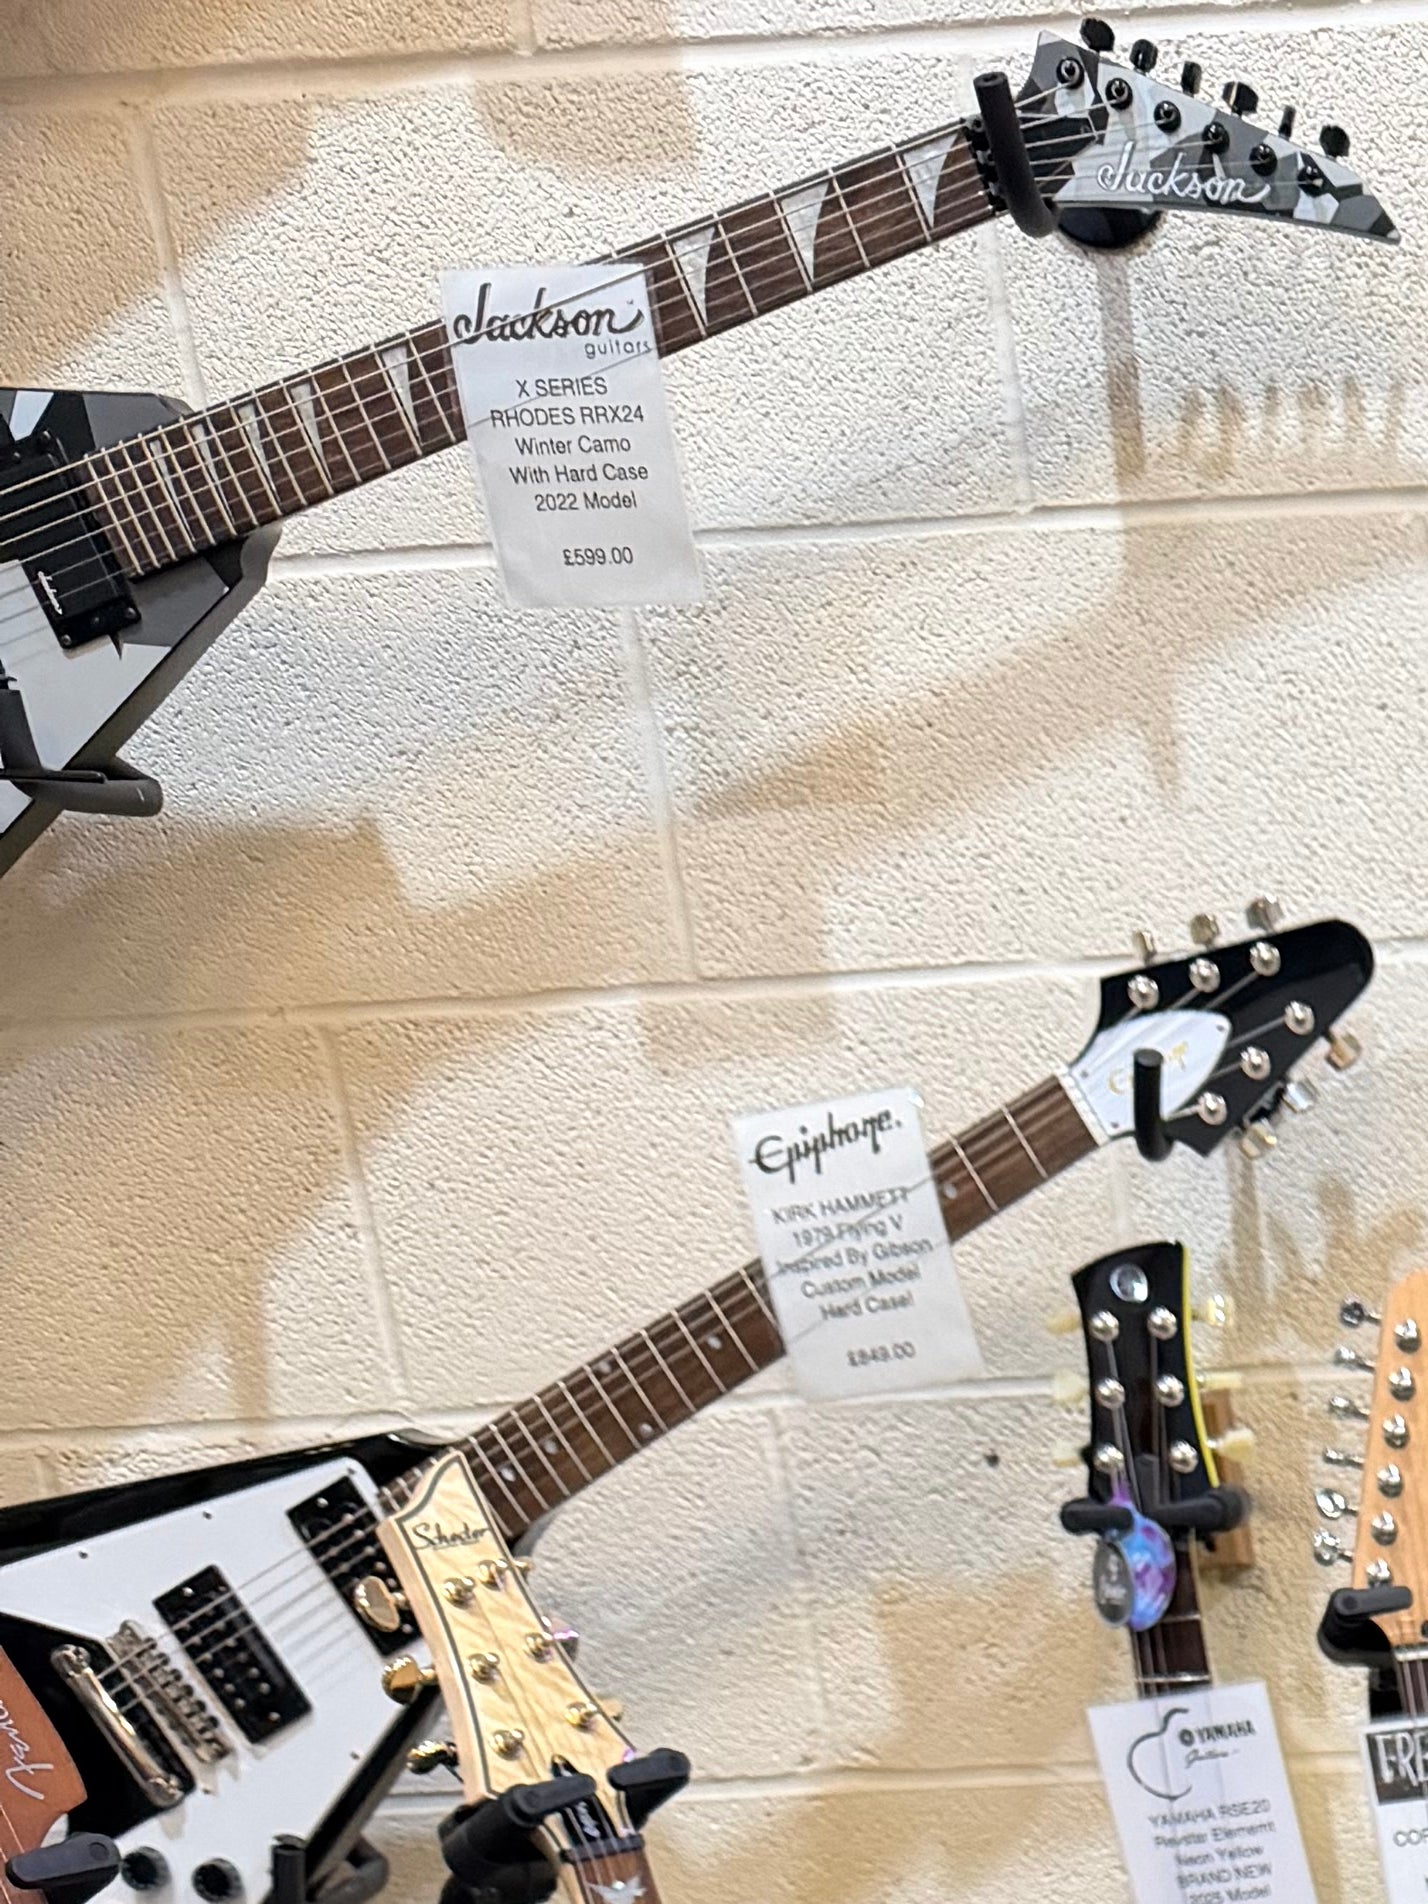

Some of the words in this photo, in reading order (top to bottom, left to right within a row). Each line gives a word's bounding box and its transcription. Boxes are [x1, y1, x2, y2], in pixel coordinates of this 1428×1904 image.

[1097, 141, 1270, 204] Jackson
[453, 282, 644, 344] Jackson
[584, 340, 650, 359] guitars
[516, 379, 530, 398] X
[536, 377, 608, 396] SERIES
[491, 407, 575, 428] RHODES
[581, 405, 644, 425] RRX24
[515, 436, 572, 456] Winter
[578, 435, 631, 453] Camo
[509, 465, 549, 485] With
[555, 465, 598, 483] Hard
[604, 464, 649, 480] Case
[536, 493, 579, 512] 2022
[584, 491, 637, 509] Model
[563, 547, 633, 566] £599.00
[1196, 1720, 1255, 1743] YAMAHA
